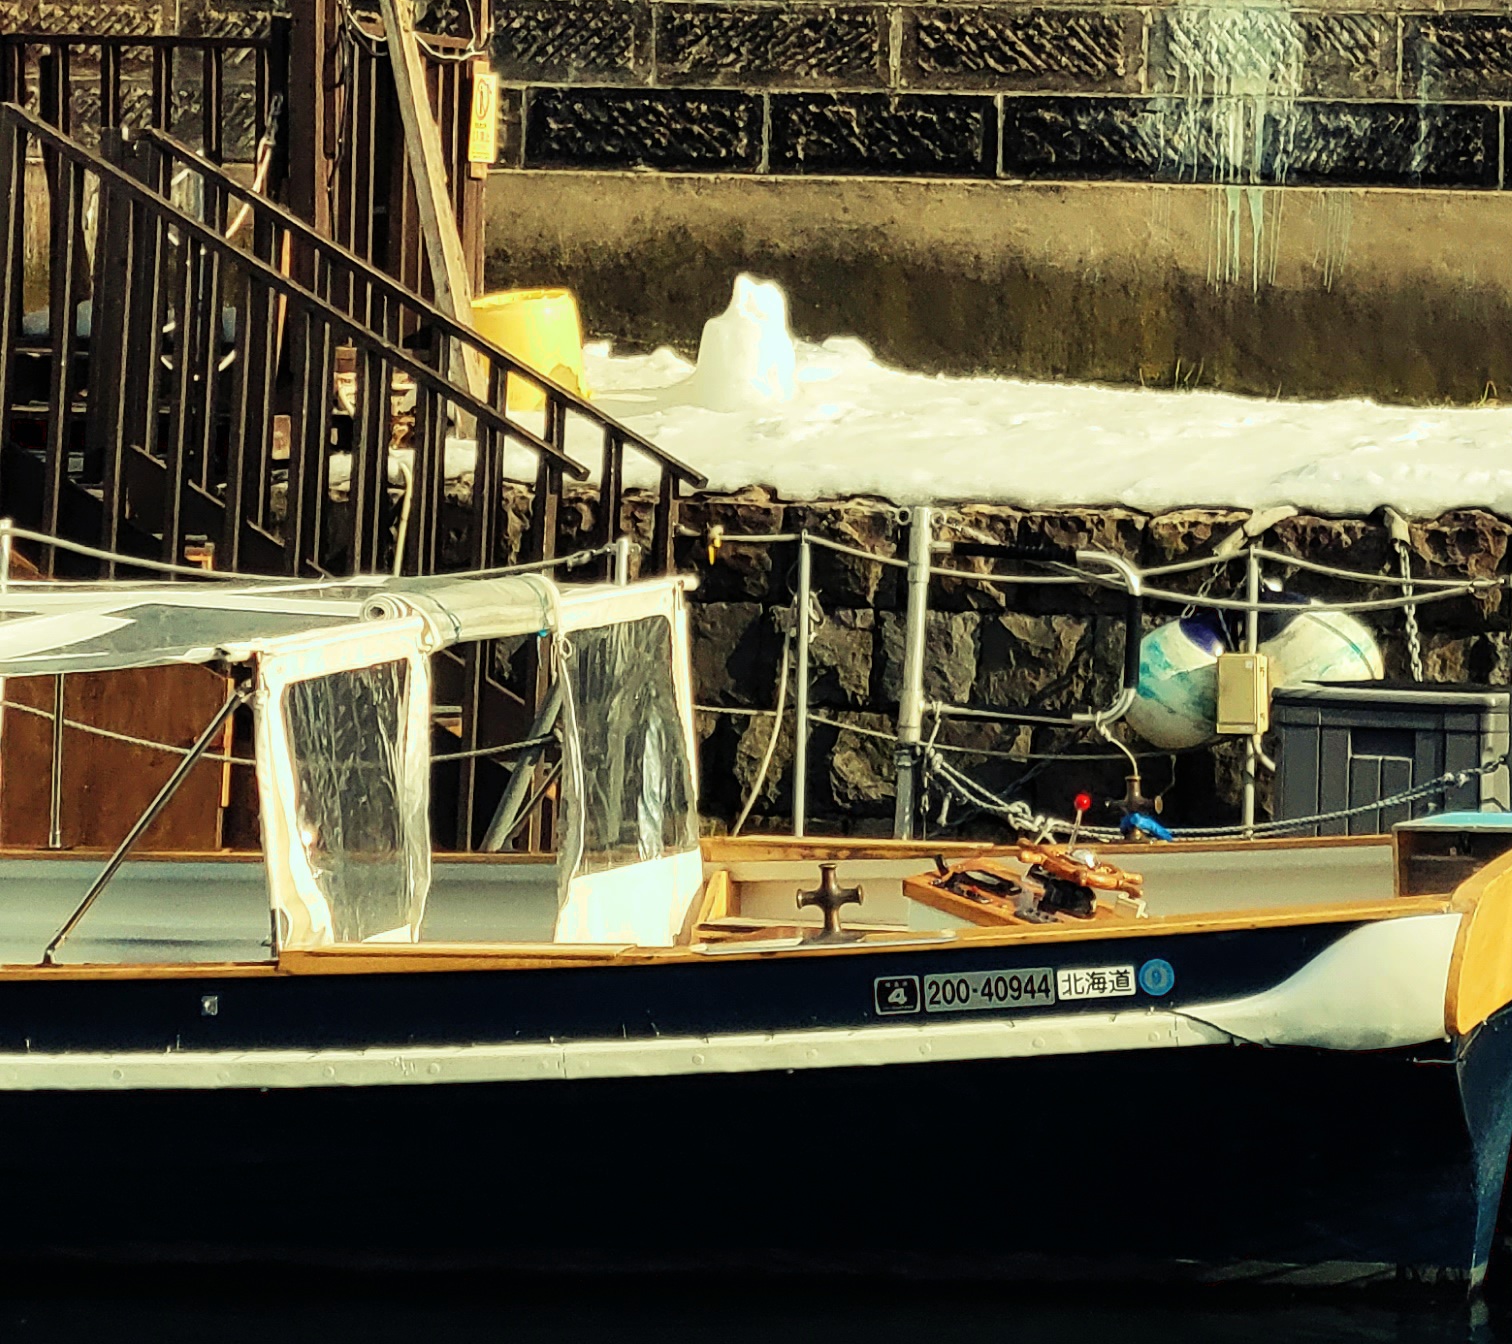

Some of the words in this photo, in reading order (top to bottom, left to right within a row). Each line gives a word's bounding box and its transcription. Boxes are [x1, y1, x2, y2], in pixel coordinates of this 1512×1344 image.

[928, 974, 1050, 1005] 200-40944
[1062, 969, 1132, 996] 北海道
